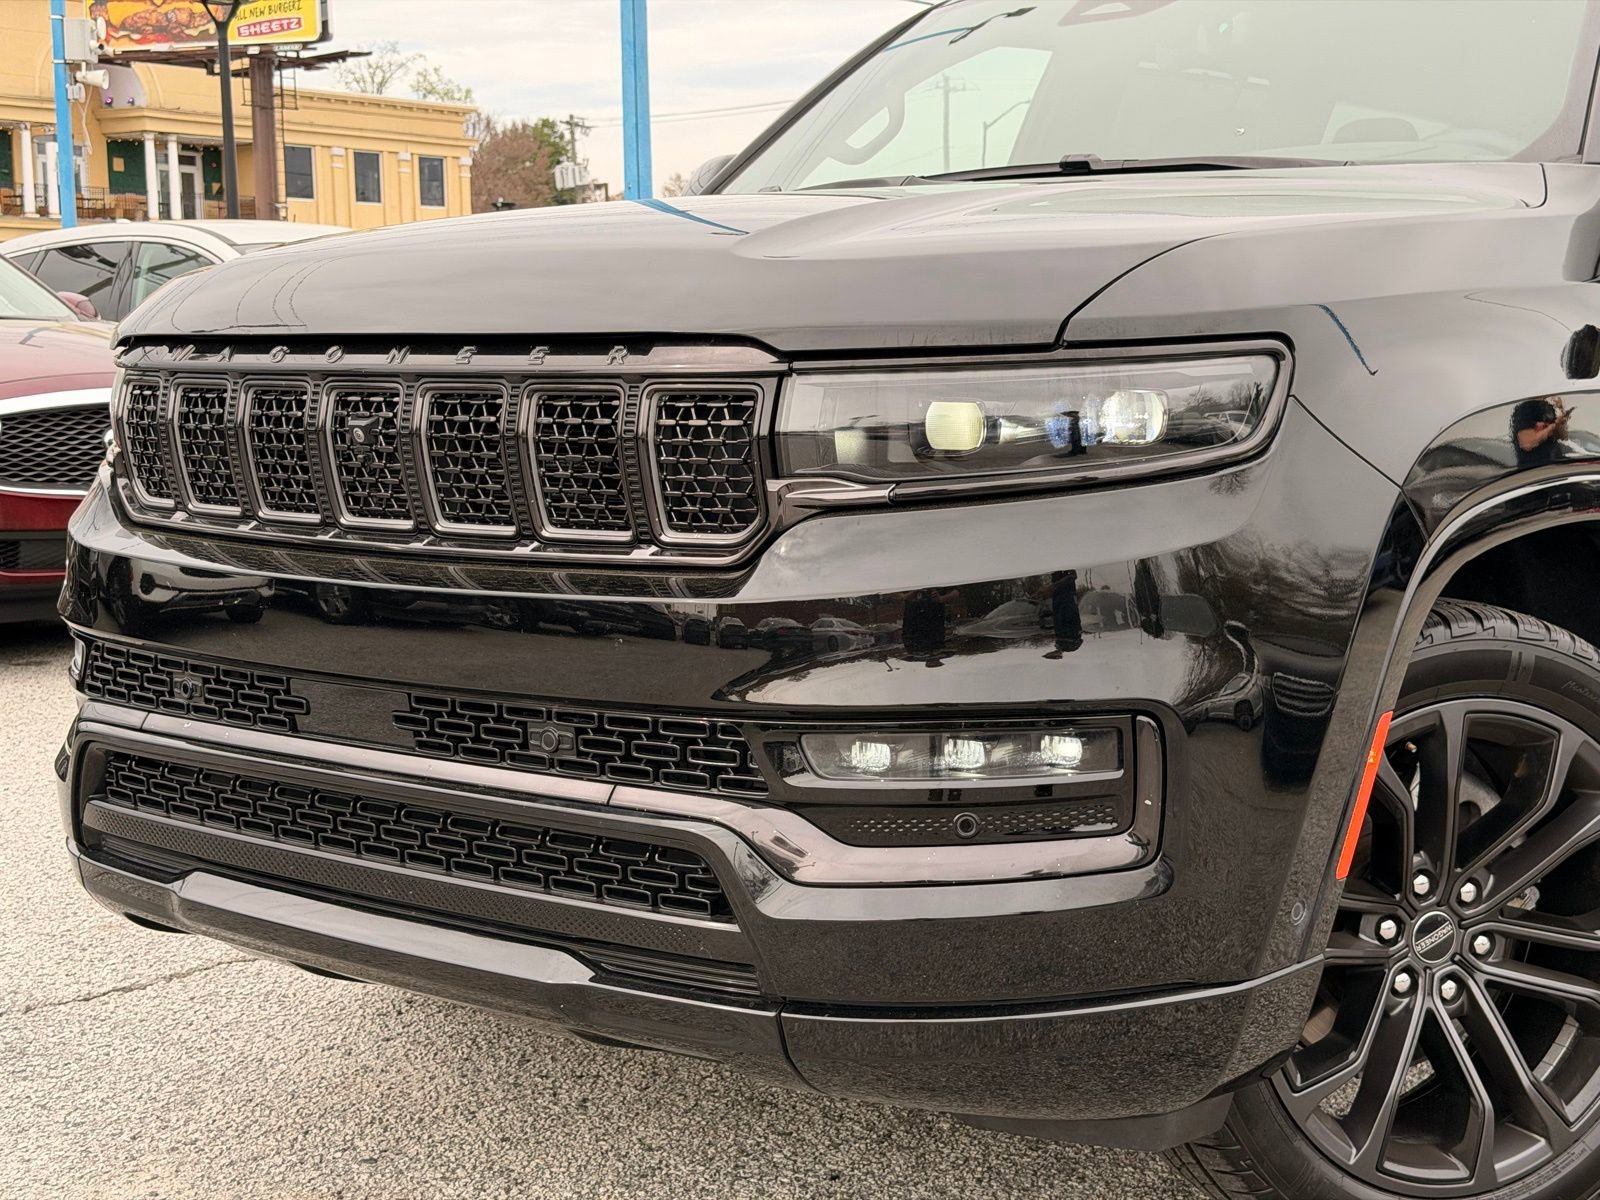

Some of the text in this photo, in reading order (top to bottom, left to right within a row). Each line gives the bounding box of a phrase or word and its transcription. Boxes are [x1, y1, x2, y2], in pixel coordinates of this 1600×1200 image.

[249, 5, 266, 18] NEW
[239, 18, 300, 36] SHEETZ
[170, 344, 629, 365] WAGONEER
[1415, 923, 1454, 952] WAGONEER
